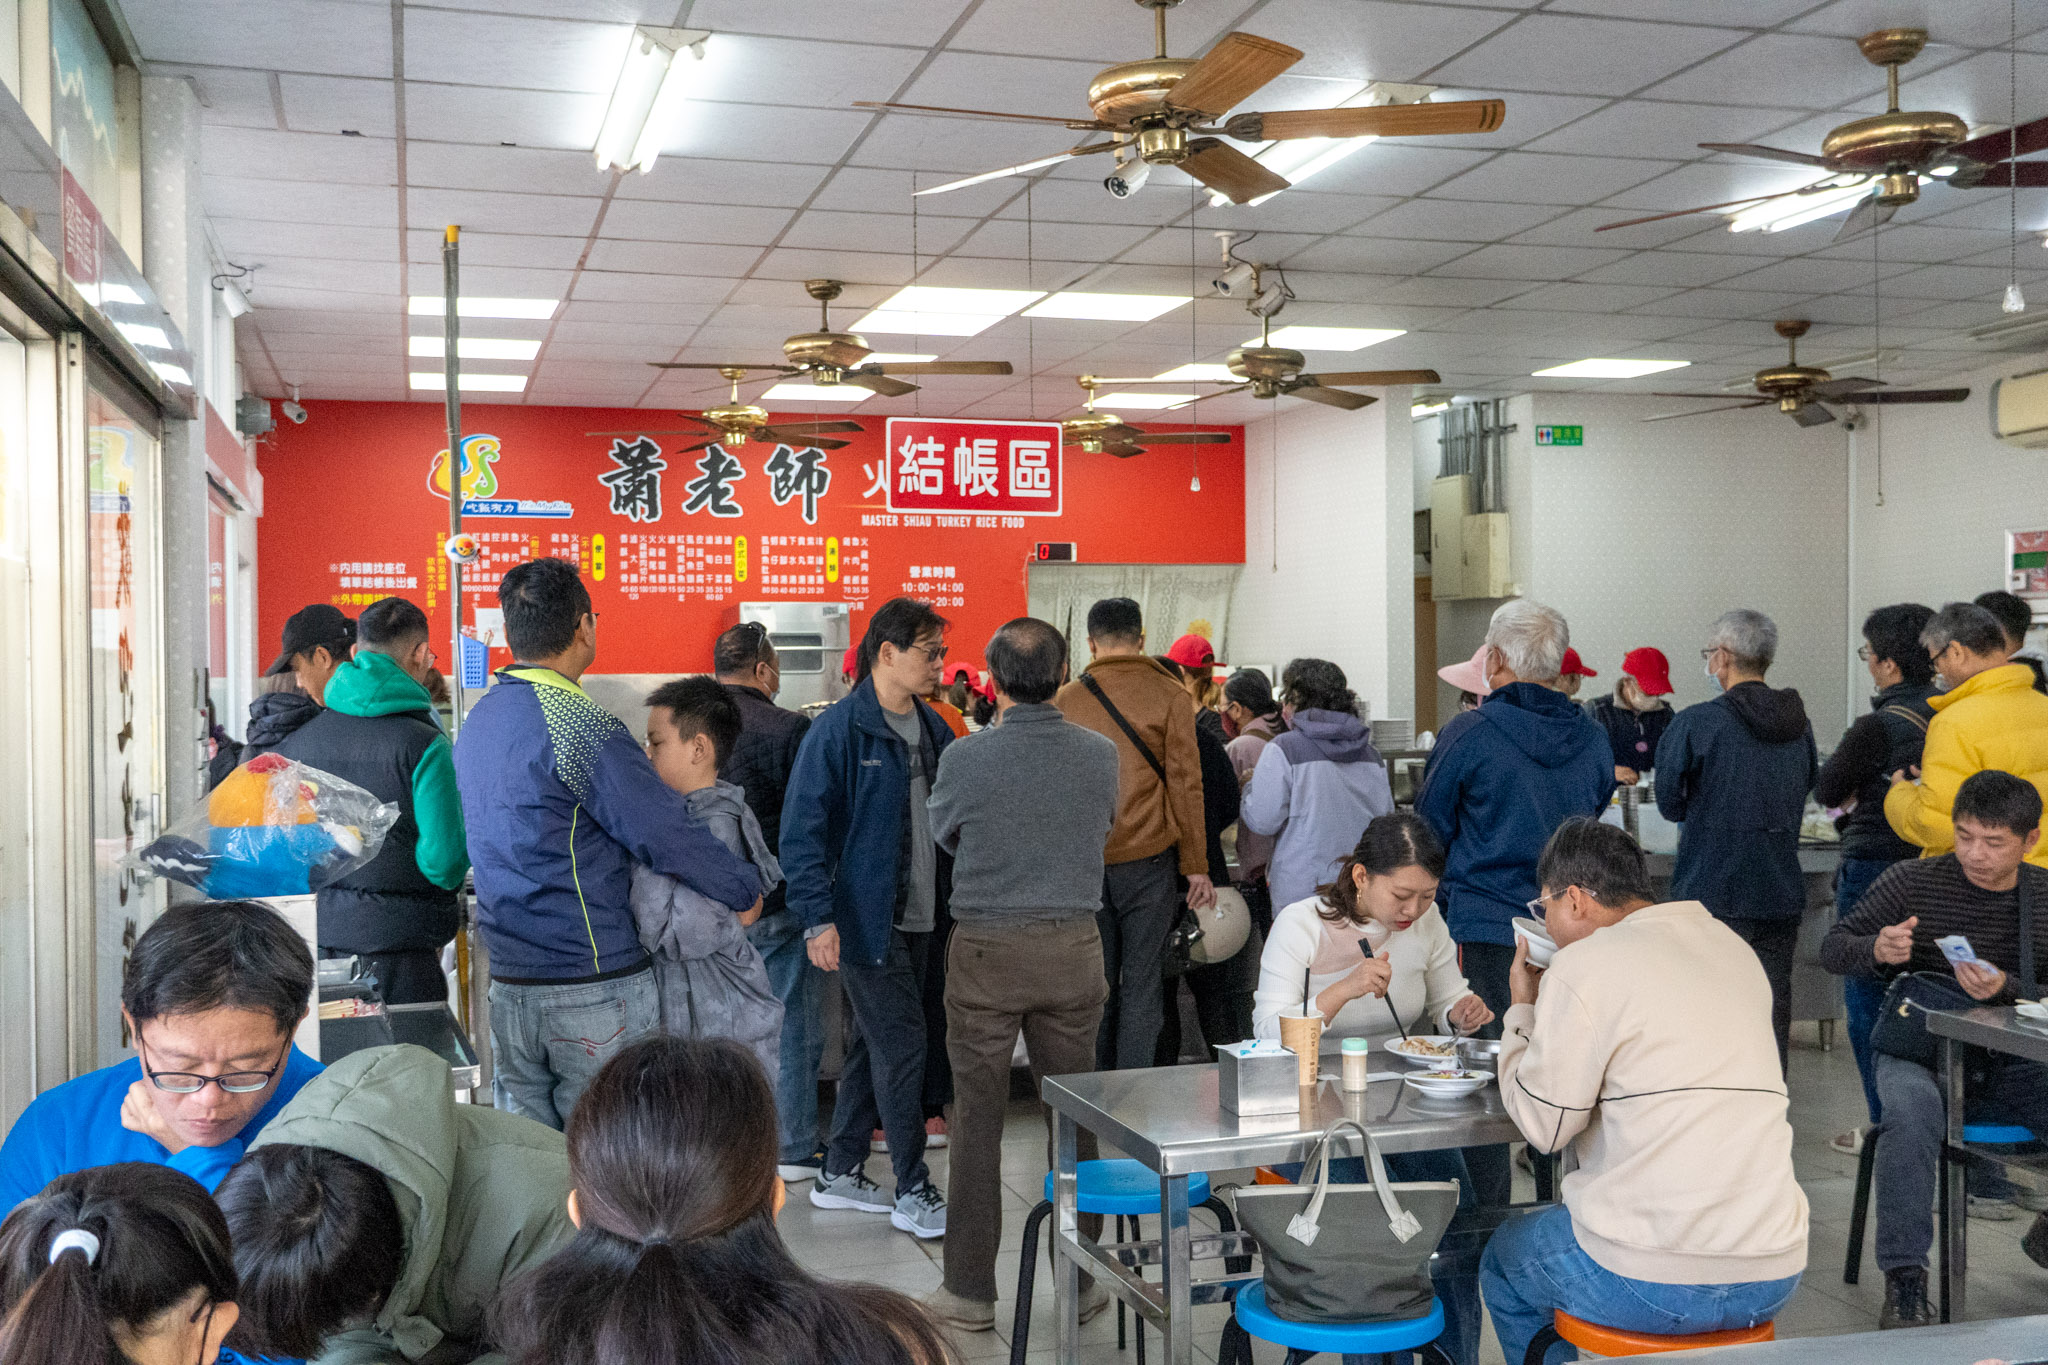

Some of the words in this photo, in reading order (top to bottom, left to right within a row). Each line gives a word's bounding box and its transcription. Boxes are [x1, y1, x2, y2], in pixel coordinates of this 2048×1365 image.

[898, 435, 1052, 498] 結帳區
[861, 515, 898, 527] MASTER
[904, 516, 931, 527] SHIAU
[936, 516, 971, 528] TURKEY
[976, 517, 997, 528] RICE
[1002, 517, 1024, 528] FOOD
[910, 566, 955, 579] 營業時間
[902, 582, 964, 593] 10:00~14:00
